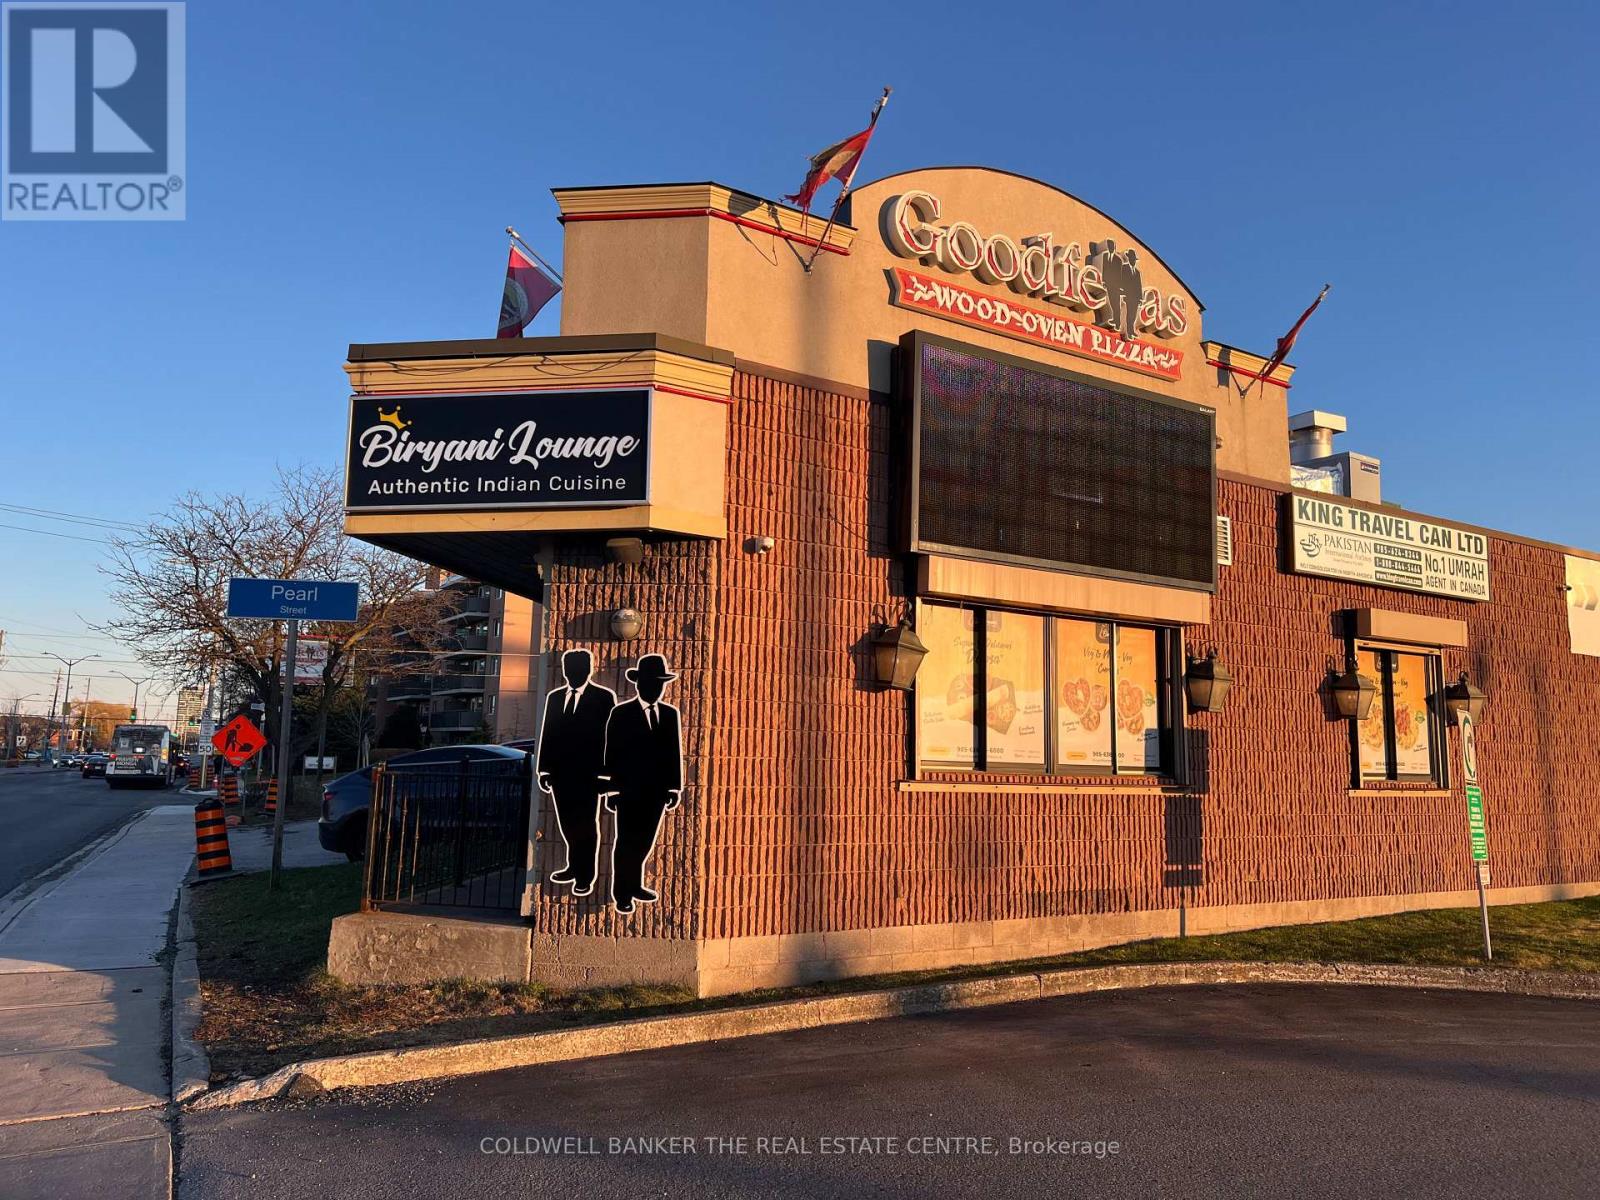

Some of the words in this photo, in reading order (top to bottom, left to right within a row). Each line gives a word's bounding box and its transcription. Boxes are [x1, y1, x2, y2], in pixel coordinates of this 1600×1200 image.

[880, 190, 1187, 336] Goodfeas
[359, 425, 504, 473] Biryani
[508, 420, 640, 470] Lounge
[368, 477, 469, 495] Authentic
[477, 476, 540, 492] Indian
[549, 475, 626, 491] Cuisine
[1298, 499, 1342, 527] KING
[1348, 509, 1415, 542] TRAVEL
[1419, 524, 1451, 549] CAN
[1458, 533, 1484, 555] LTD
[1324, 534, 1372, 554] PAKISTAN
[1425, 553, 1446, 575] No.1
[1448, 557, 1485, 581] UMRAH
[271, 585, 318, 601] Pearl
[1425, 575, 1446, 590] AGENT
[1450, 579, 1457, 591] IN
[1460, 581, 1486, 596] CANADA
[280, 605, 307, 615] Street
